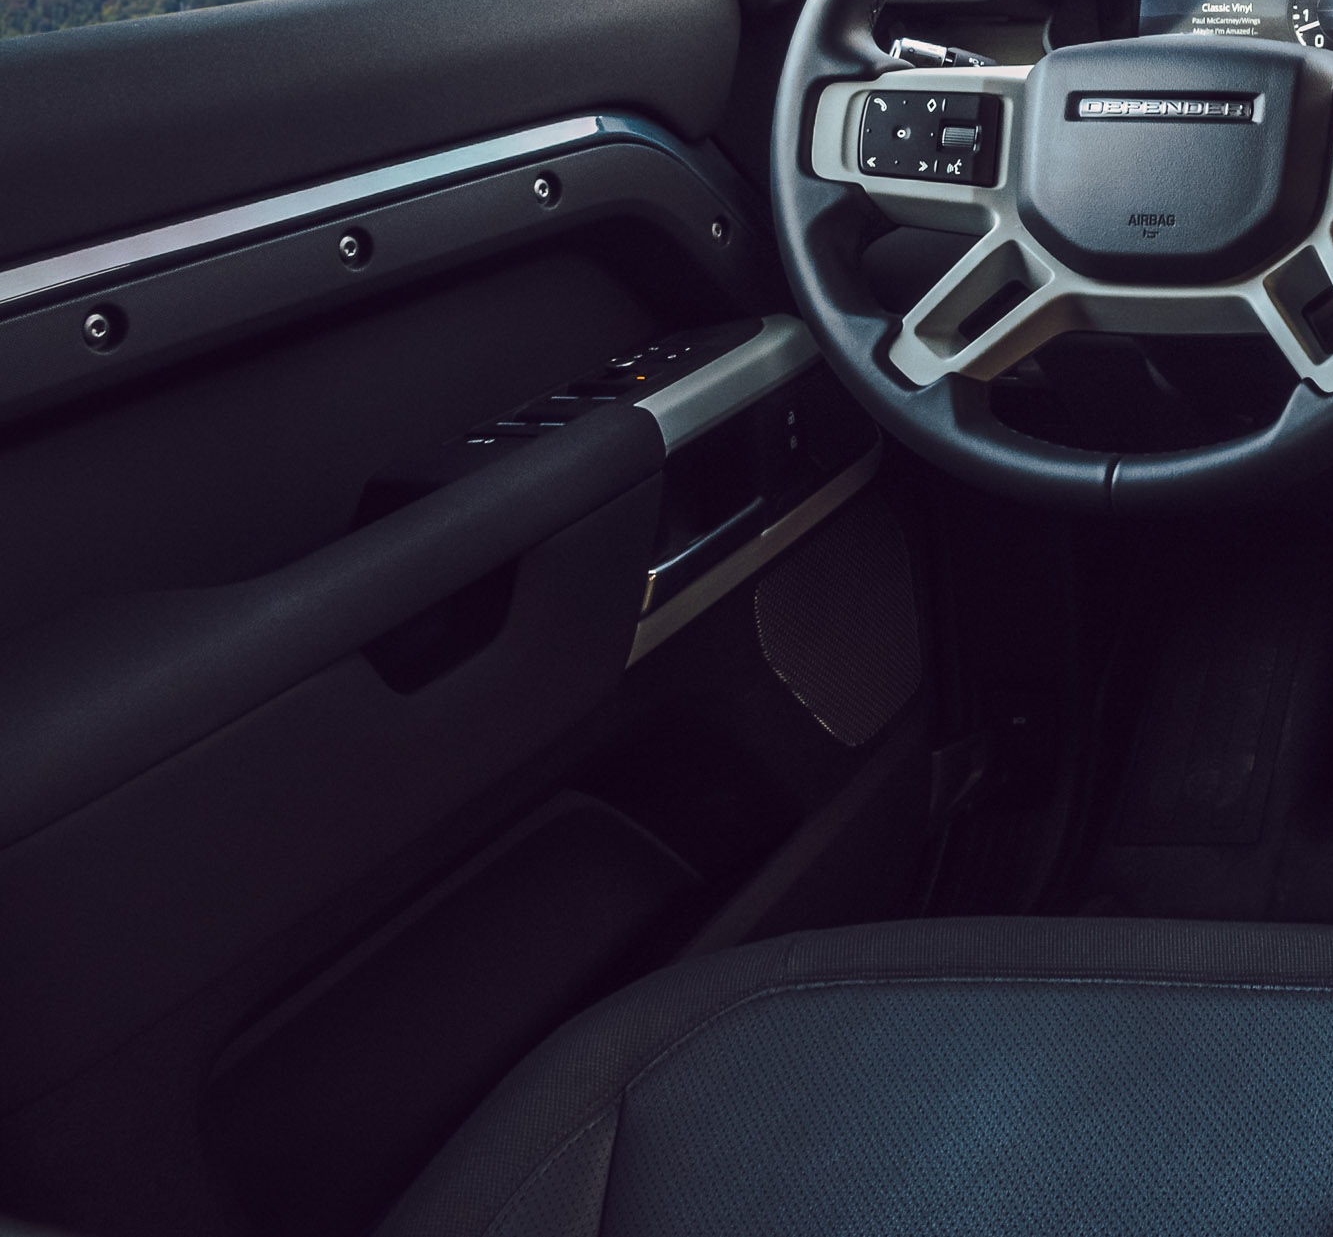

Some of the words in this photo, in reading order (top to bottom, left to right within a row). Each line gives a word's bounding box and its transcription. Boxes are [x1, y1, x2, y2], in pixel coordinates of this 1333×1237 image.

[1202, 3, 1231, 13] Classic
[1231, 3, 1253, 14] Vinyl
[1207, 18, 1261, 26] McCartney/Wings
[1303, 9, 1309, 22] 1
[1193, 28, 1214, 36] Maybe
[1315, 34, 1325, 48] 0
[1086, 100, 1246, 116] DEFENDER
[1128, 214, 1175, 227] AIRBAG
